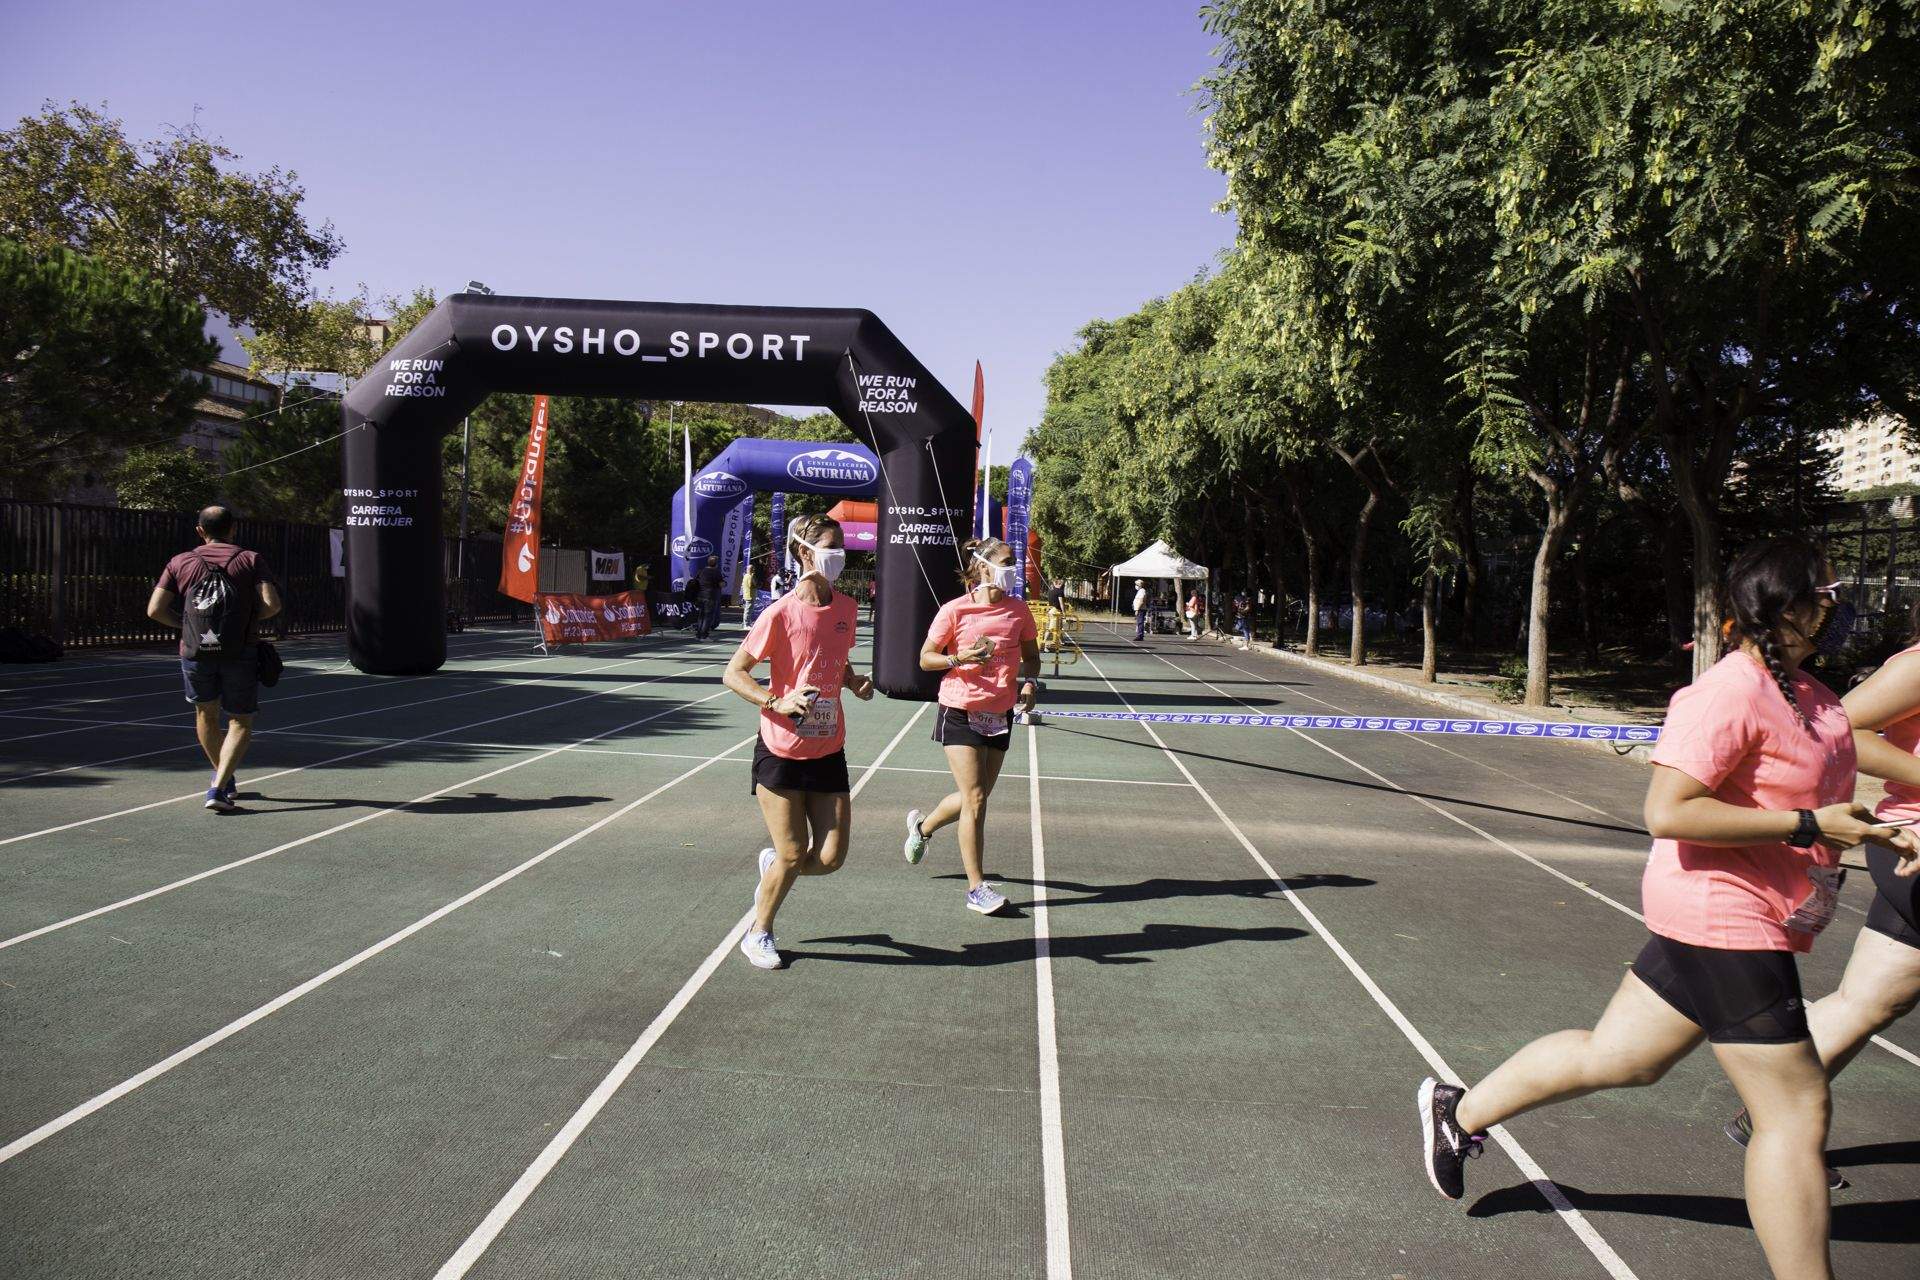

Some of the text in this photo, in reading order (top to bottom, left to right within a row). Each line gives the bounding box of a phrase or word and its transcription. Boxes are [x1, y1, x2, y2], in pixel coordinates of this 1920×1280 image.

[491, 324, 811, 362] OYSHO_SPORT
[389, 359, 444, 372] WE RUN
[393, 372, 436, 384] FOR A
[858, 374, 917, 389] WE RUN
[385, 385, 446, 397] REASON
[865, 388, 909, 400] FOR A
[858, 401, 918, 414] REASON
[344, 489, 419, 499] OYSHO_SPORT
[351, 505, 402, 515] CARRERA
[888, 507, 964, 517] OYSHO_SPORT
[346, 516, 413, 527] DE LA MUJER
[898, 523, 951, 534] CARRERA
[890, 534, 959, 546] DE LA MUJER
